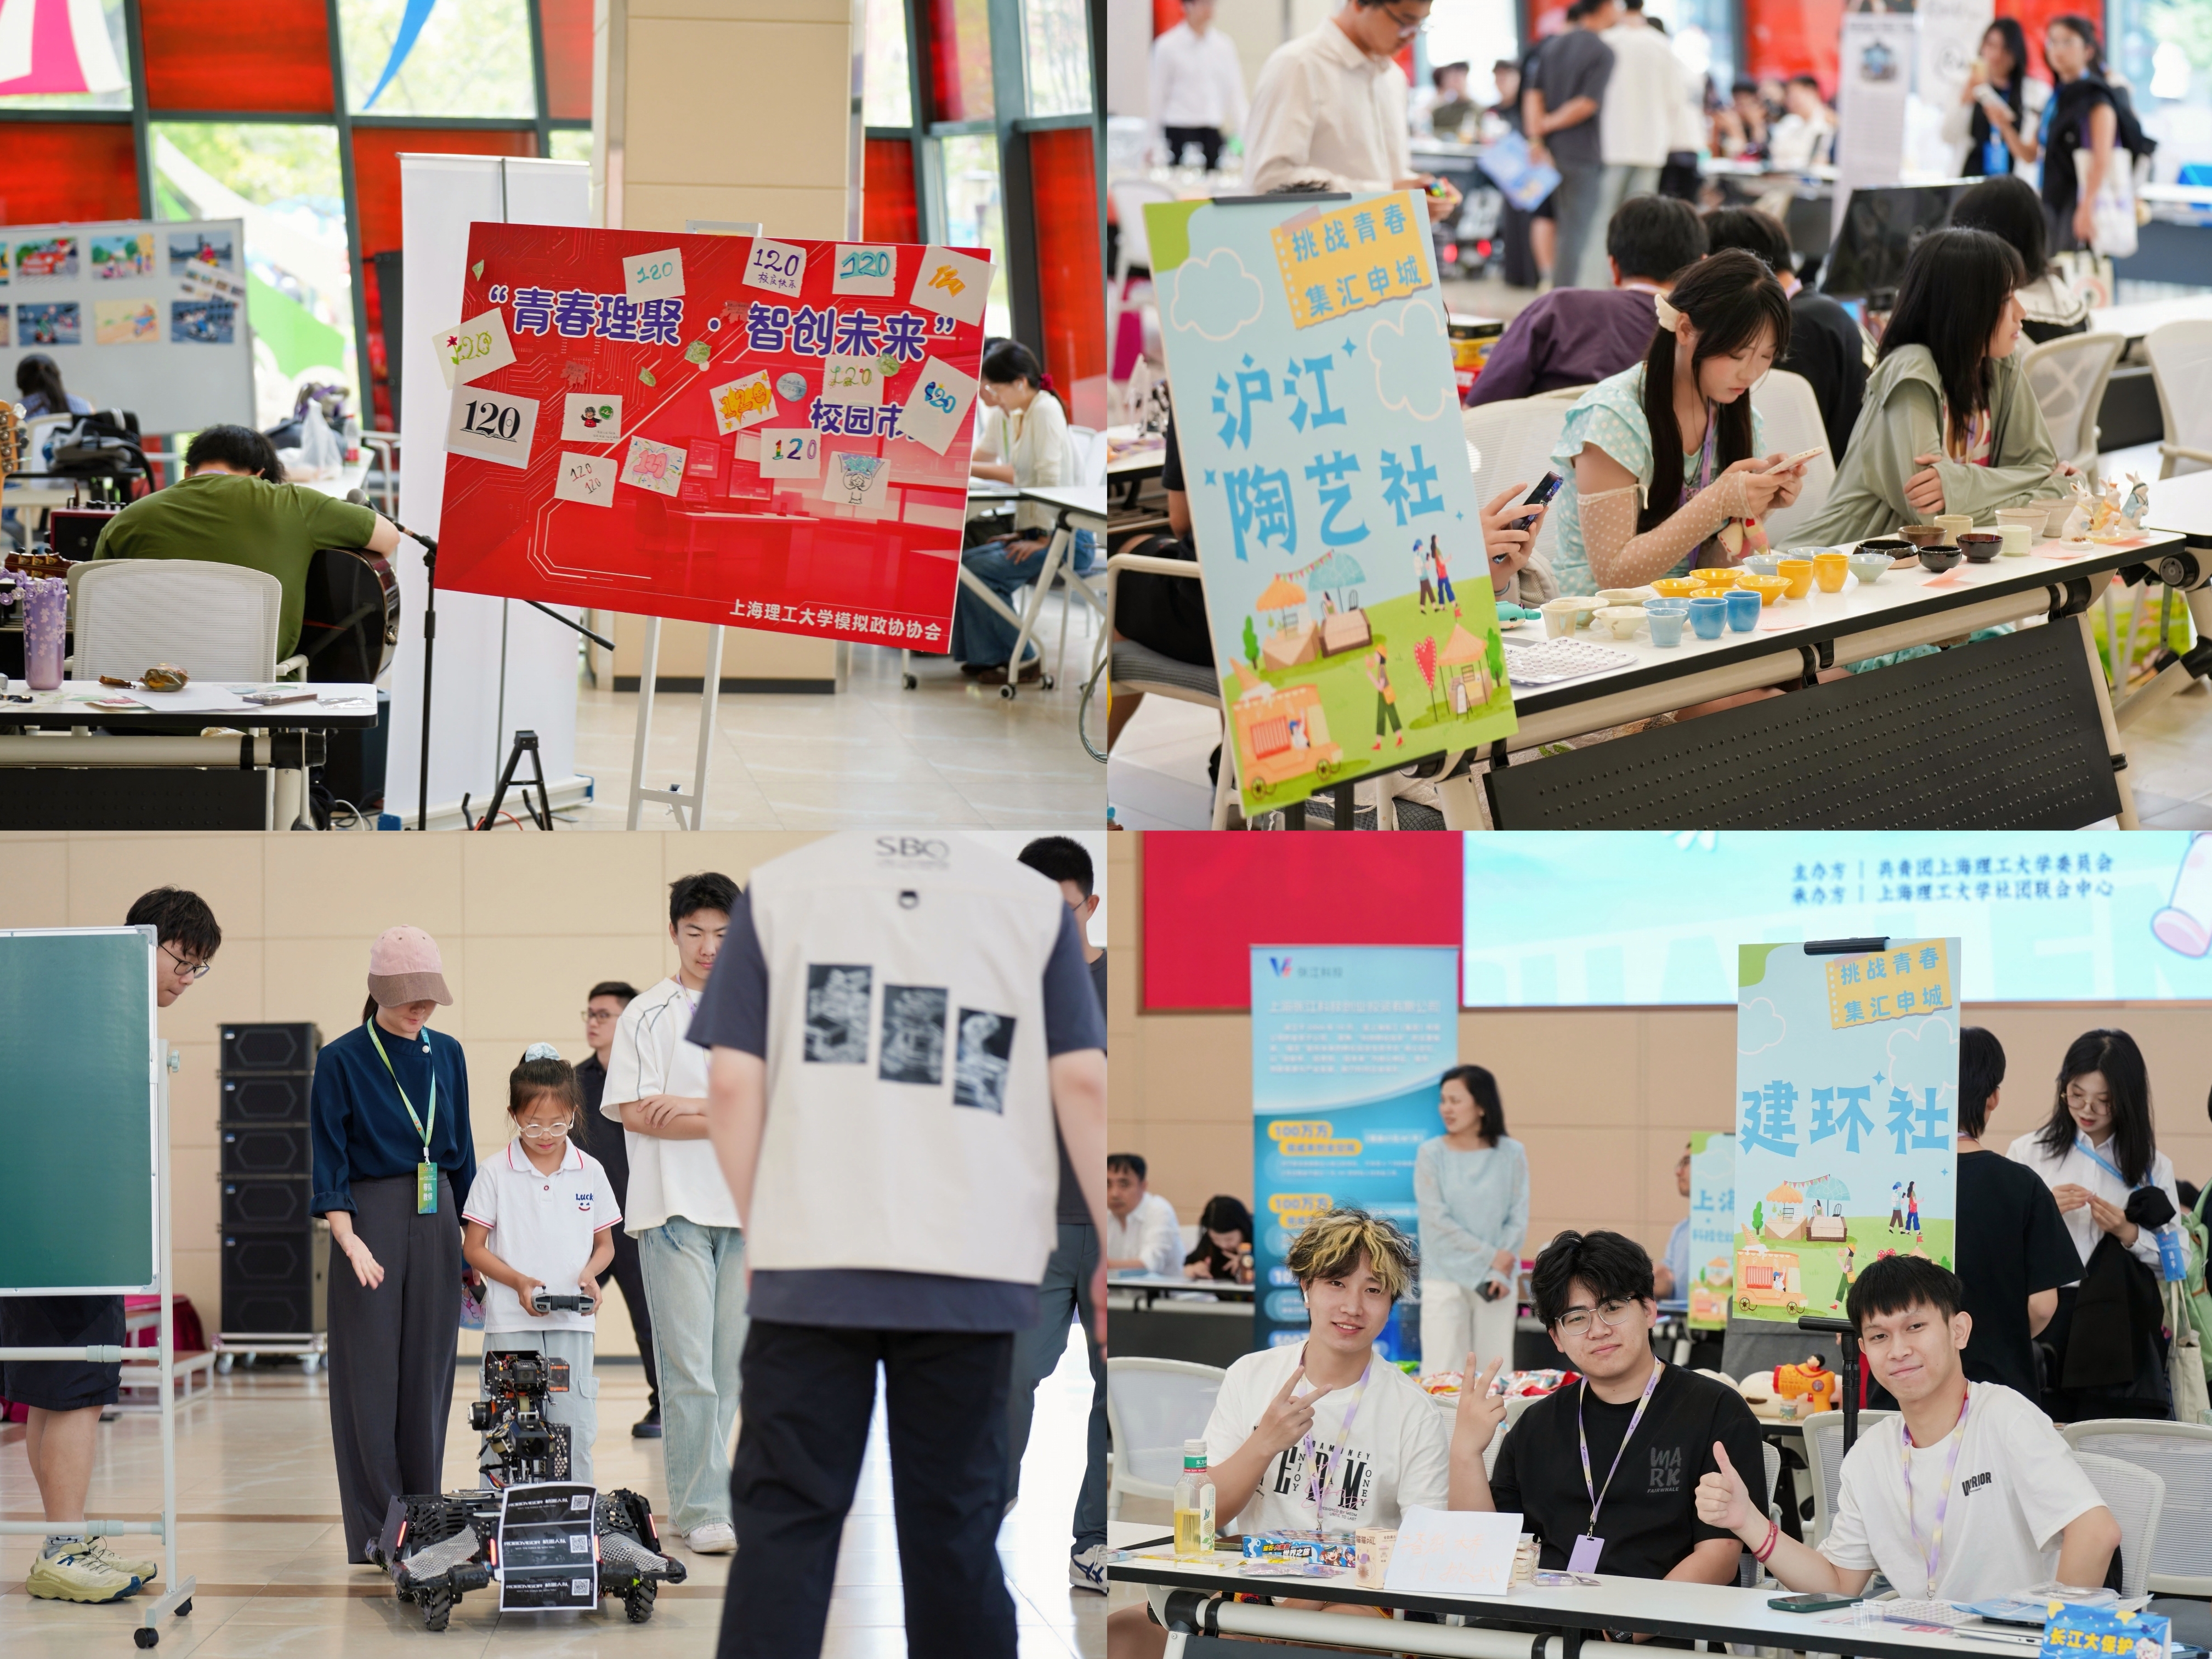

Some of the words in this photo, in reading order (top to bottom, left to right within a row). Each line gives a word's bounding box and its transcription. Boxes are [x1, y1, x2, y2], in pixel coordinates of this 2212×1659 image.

[1292, 203, 1407, 262] 挑战青春
[637, 262, 673, 284] 120
[753, 248, 799, 276] 120
[840, 251, 891, 279] 120
[1304, 255, 1422, 317] 集汇申城
[1211, 352, 1348, 450] 沪江
[462, 400, 521, 440] 120
[809, 395, 918, 442] 校园市
[773, 438, 818, 461] 120
[570, 463, 592, 482] 120
[585, 478, 602, 494] 120
[1223, 444, 1445, 563] 陶艺社
[729, 598, 941, 641] 上海理工大学模拟政协协会
[1840, 947, 1939, 986] 挑战青春
[1844, 984, 1944, 1022] 集汇申城
[1739, 1079, 1950, 1158] 建环社
[423, 1183, 433, 1191] 带队
[423, 1193, 433, 1201] 教师
[576, 1193, 594, 1202] Luck
[1962, 1472, 1992, 1496] WRIOR
[1283, 1548, 1311, 1556] 世界之旅
[43, 1572, 61, 1583] SALOMON
[2050, 1627, 2134, 1656] 长江大保护
